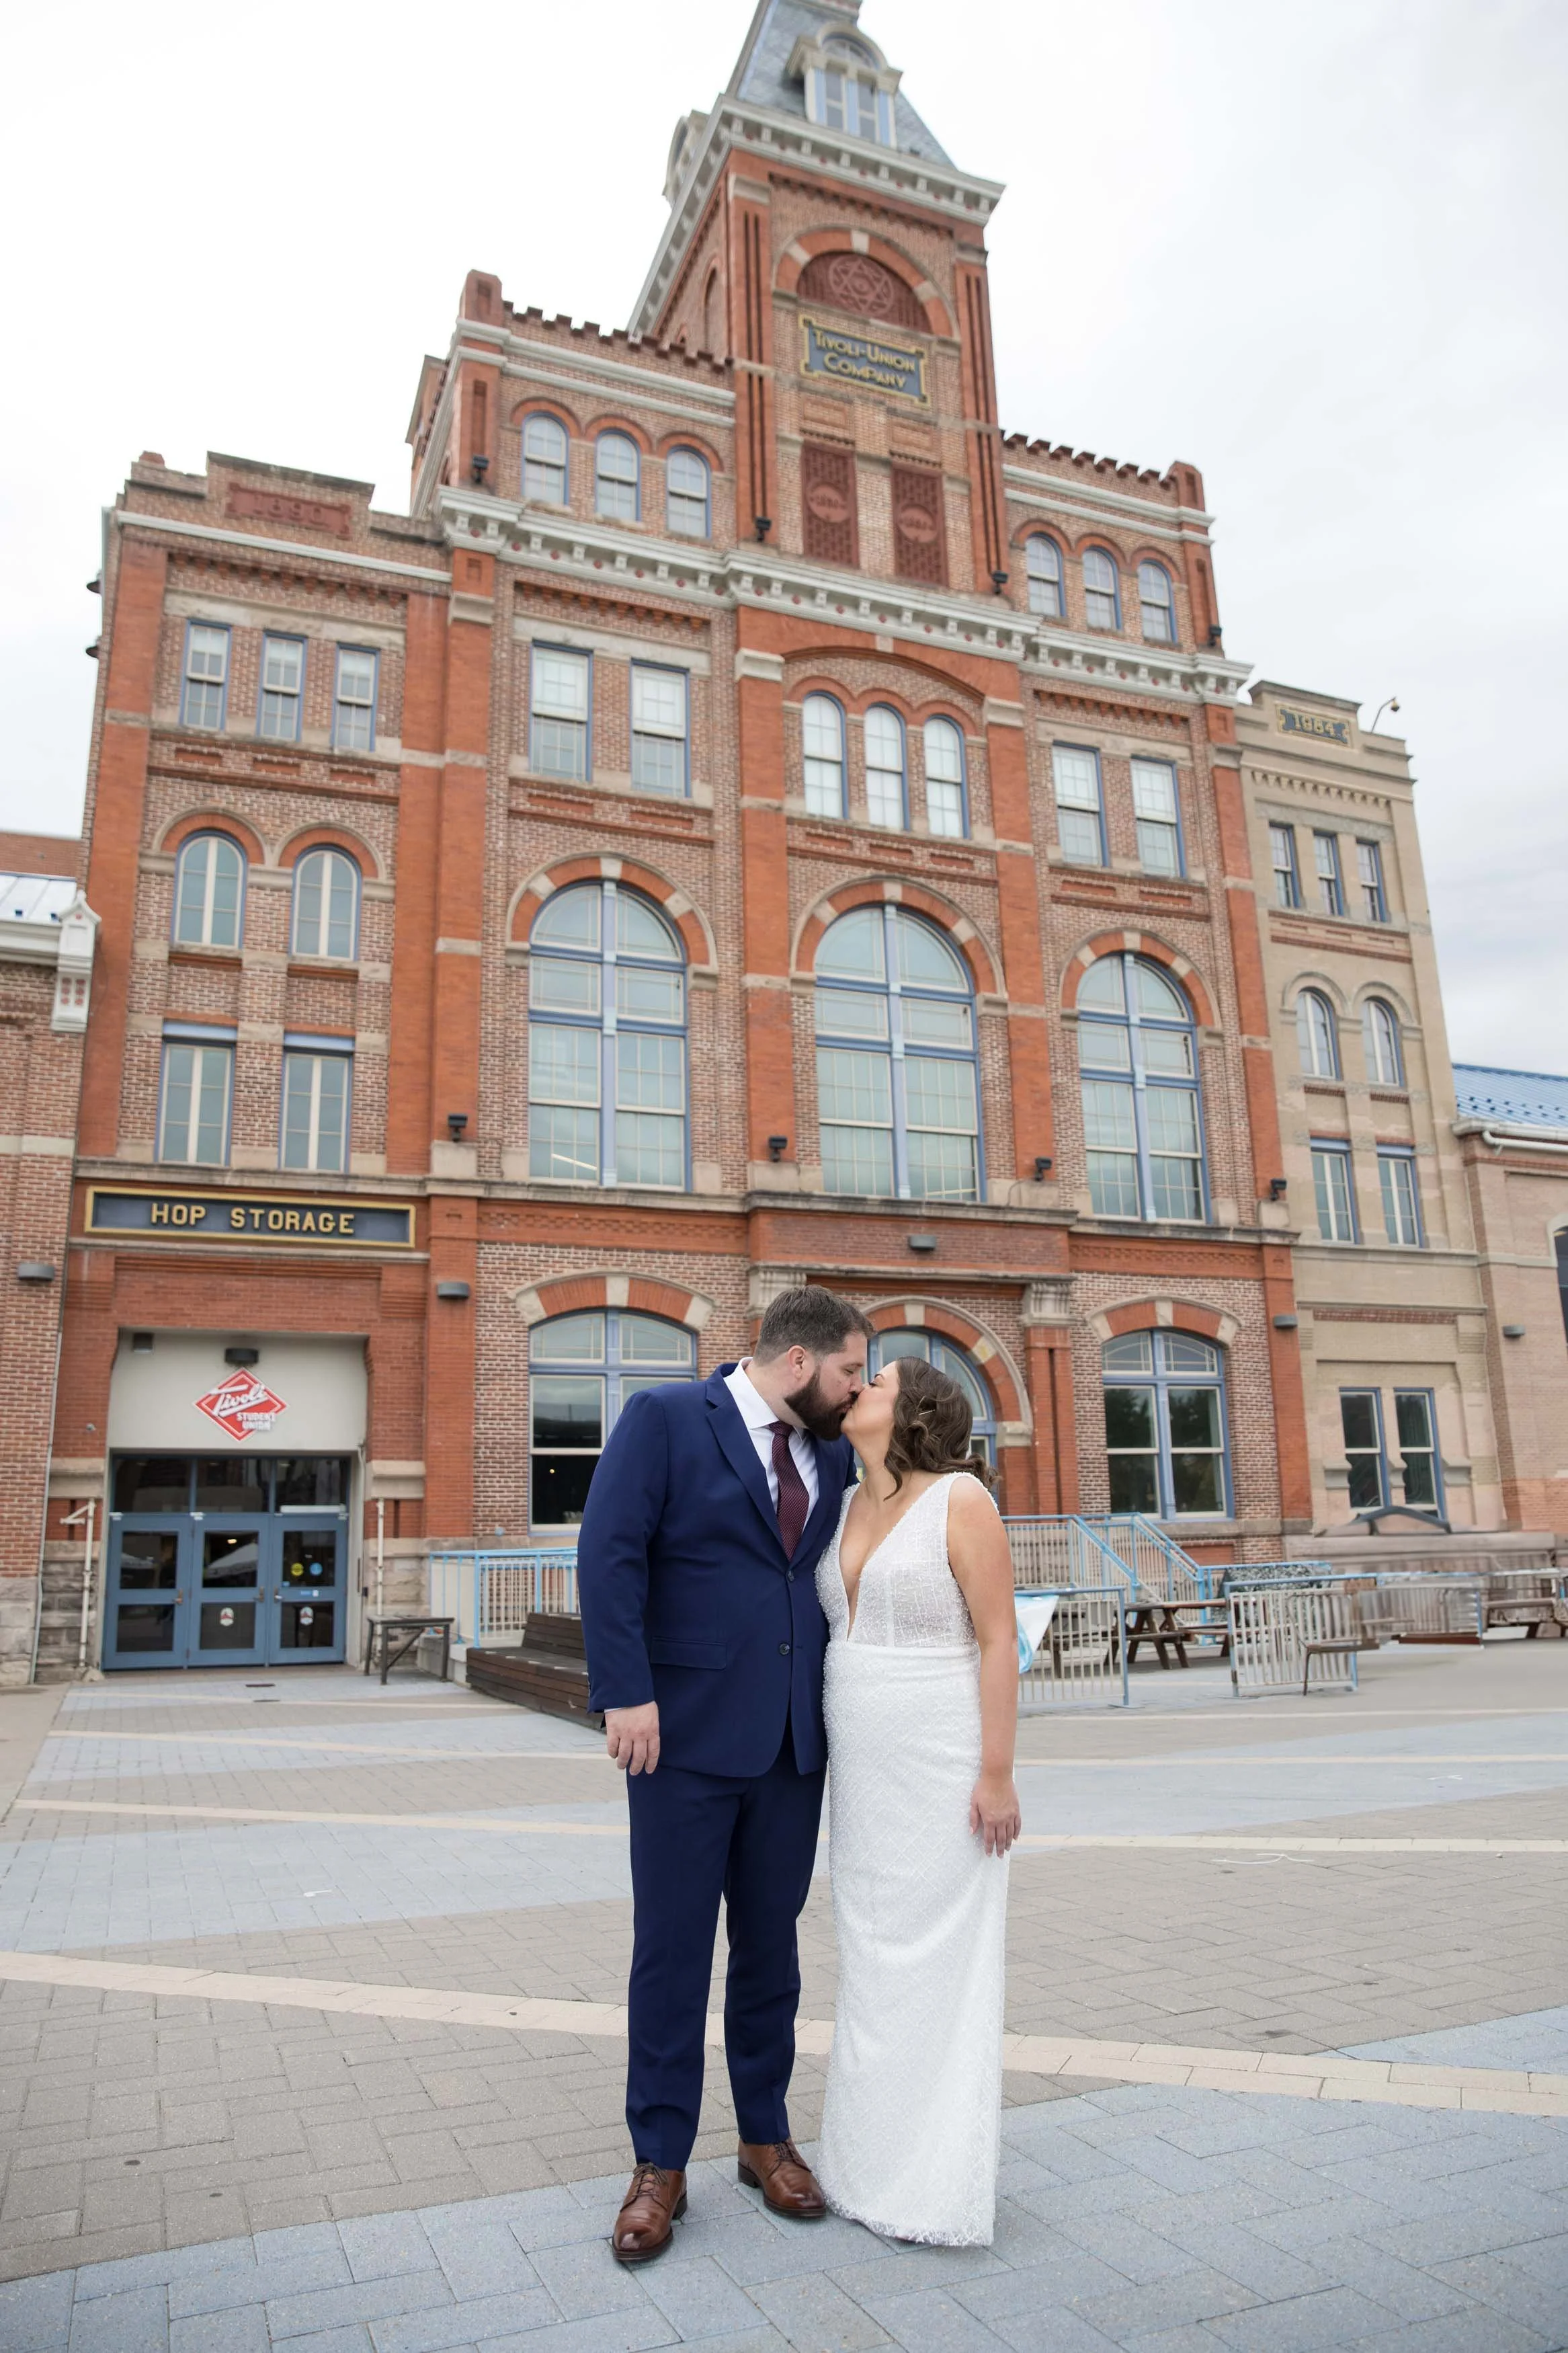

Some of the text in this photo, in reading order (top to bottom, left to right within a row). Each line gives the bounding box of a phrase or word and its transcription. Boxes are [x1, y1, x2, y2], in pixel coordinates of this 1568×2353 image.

[814, 329, 915, 372] TIVOLI-UNION
[823, 352, 907, 389] COMPANY
[151, 1202, 355, 1234] HOP STORAGE
[209, 1384, 267, 1417] Tivoli
[236, 1412, 276, 1423] STUDENT
[242, 1421, 271, 1431] UNION
